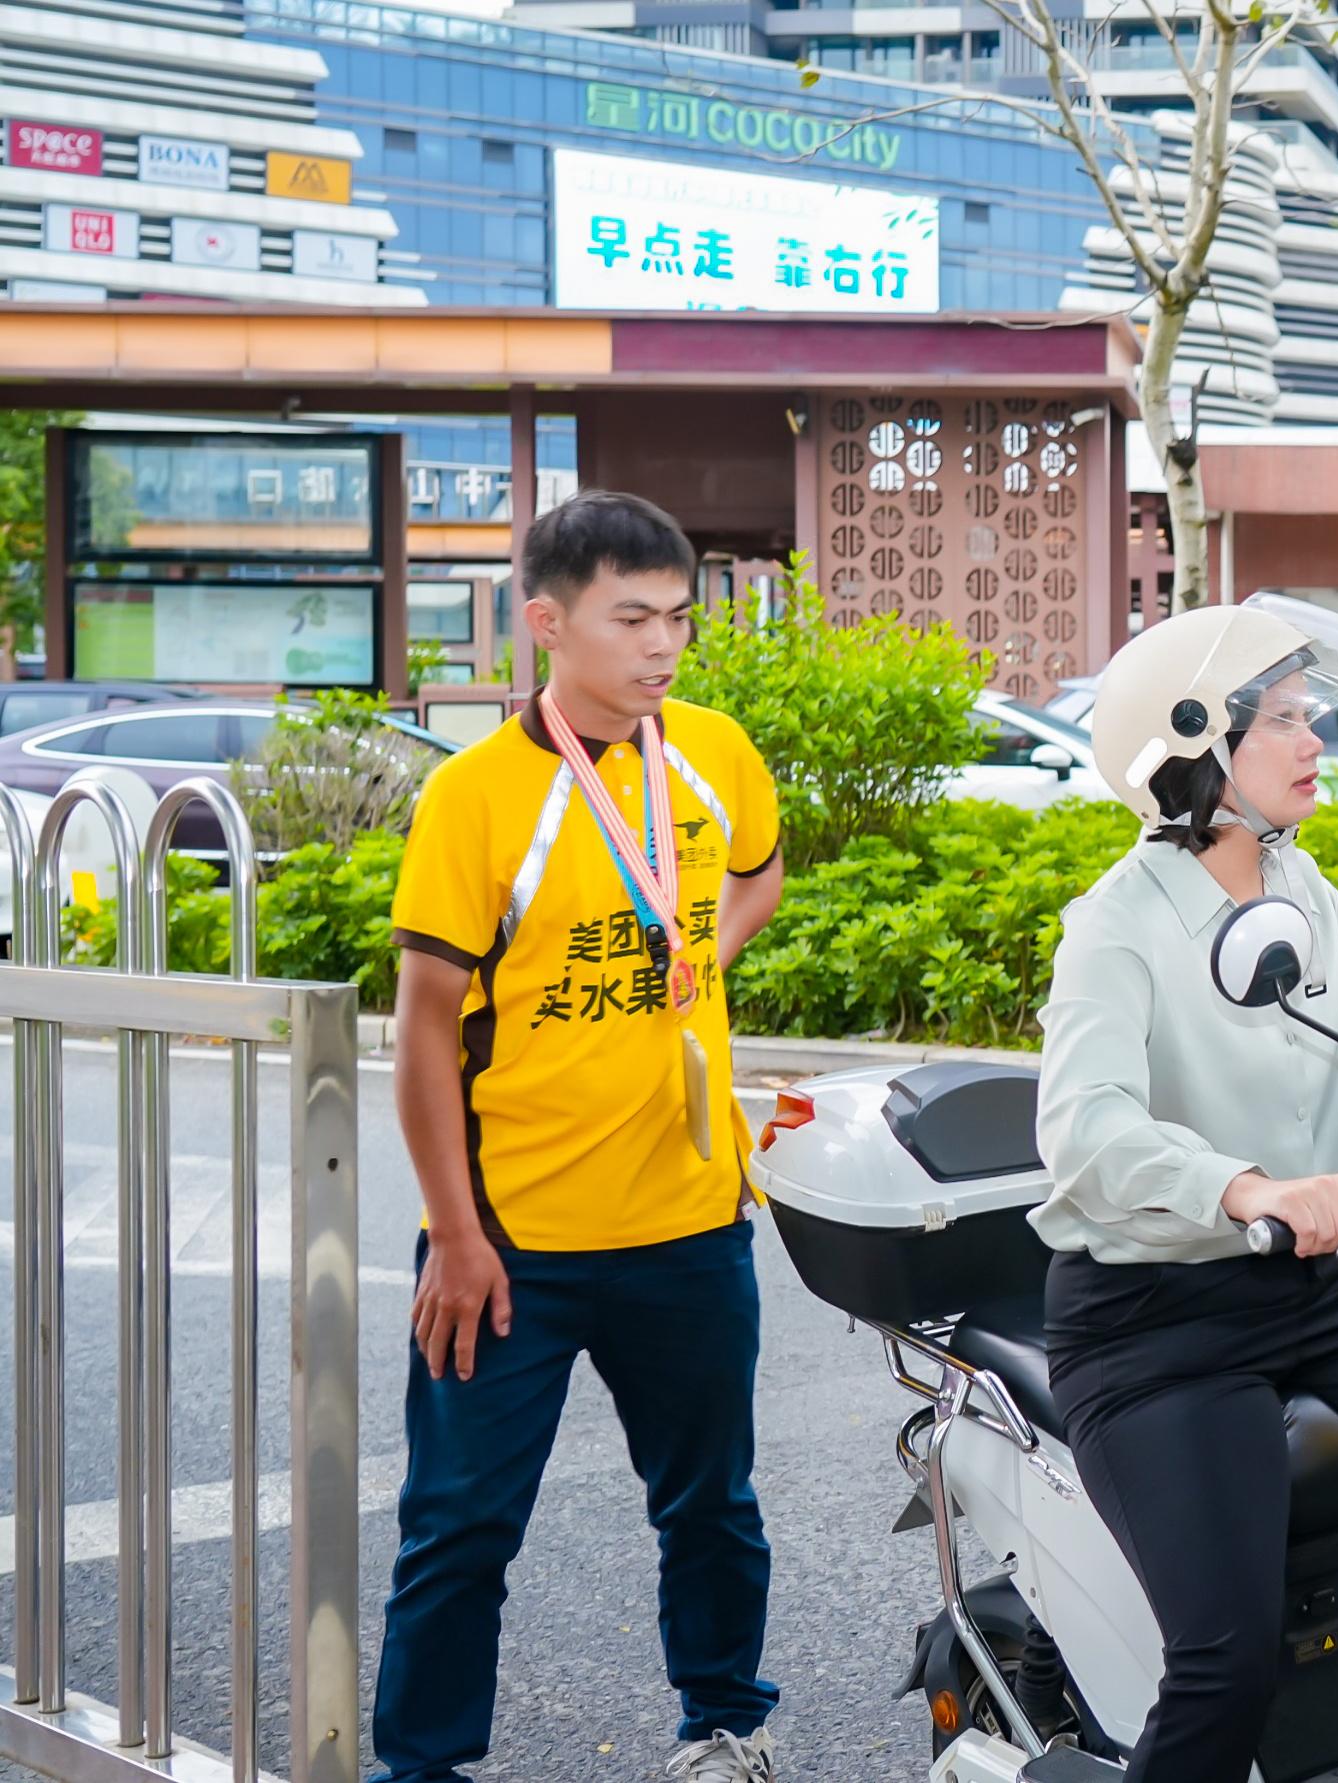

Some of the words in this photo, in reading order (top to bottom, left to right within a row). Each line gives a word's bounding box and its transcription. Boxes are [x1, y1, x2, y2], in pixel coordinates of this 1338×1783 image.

[149, 144, 219, 169] BONA
[587, 215, 733, 279] 早点走
[775, 237, 908, 299] 靠右行
[567, 897, 717, 963] 美团卖
